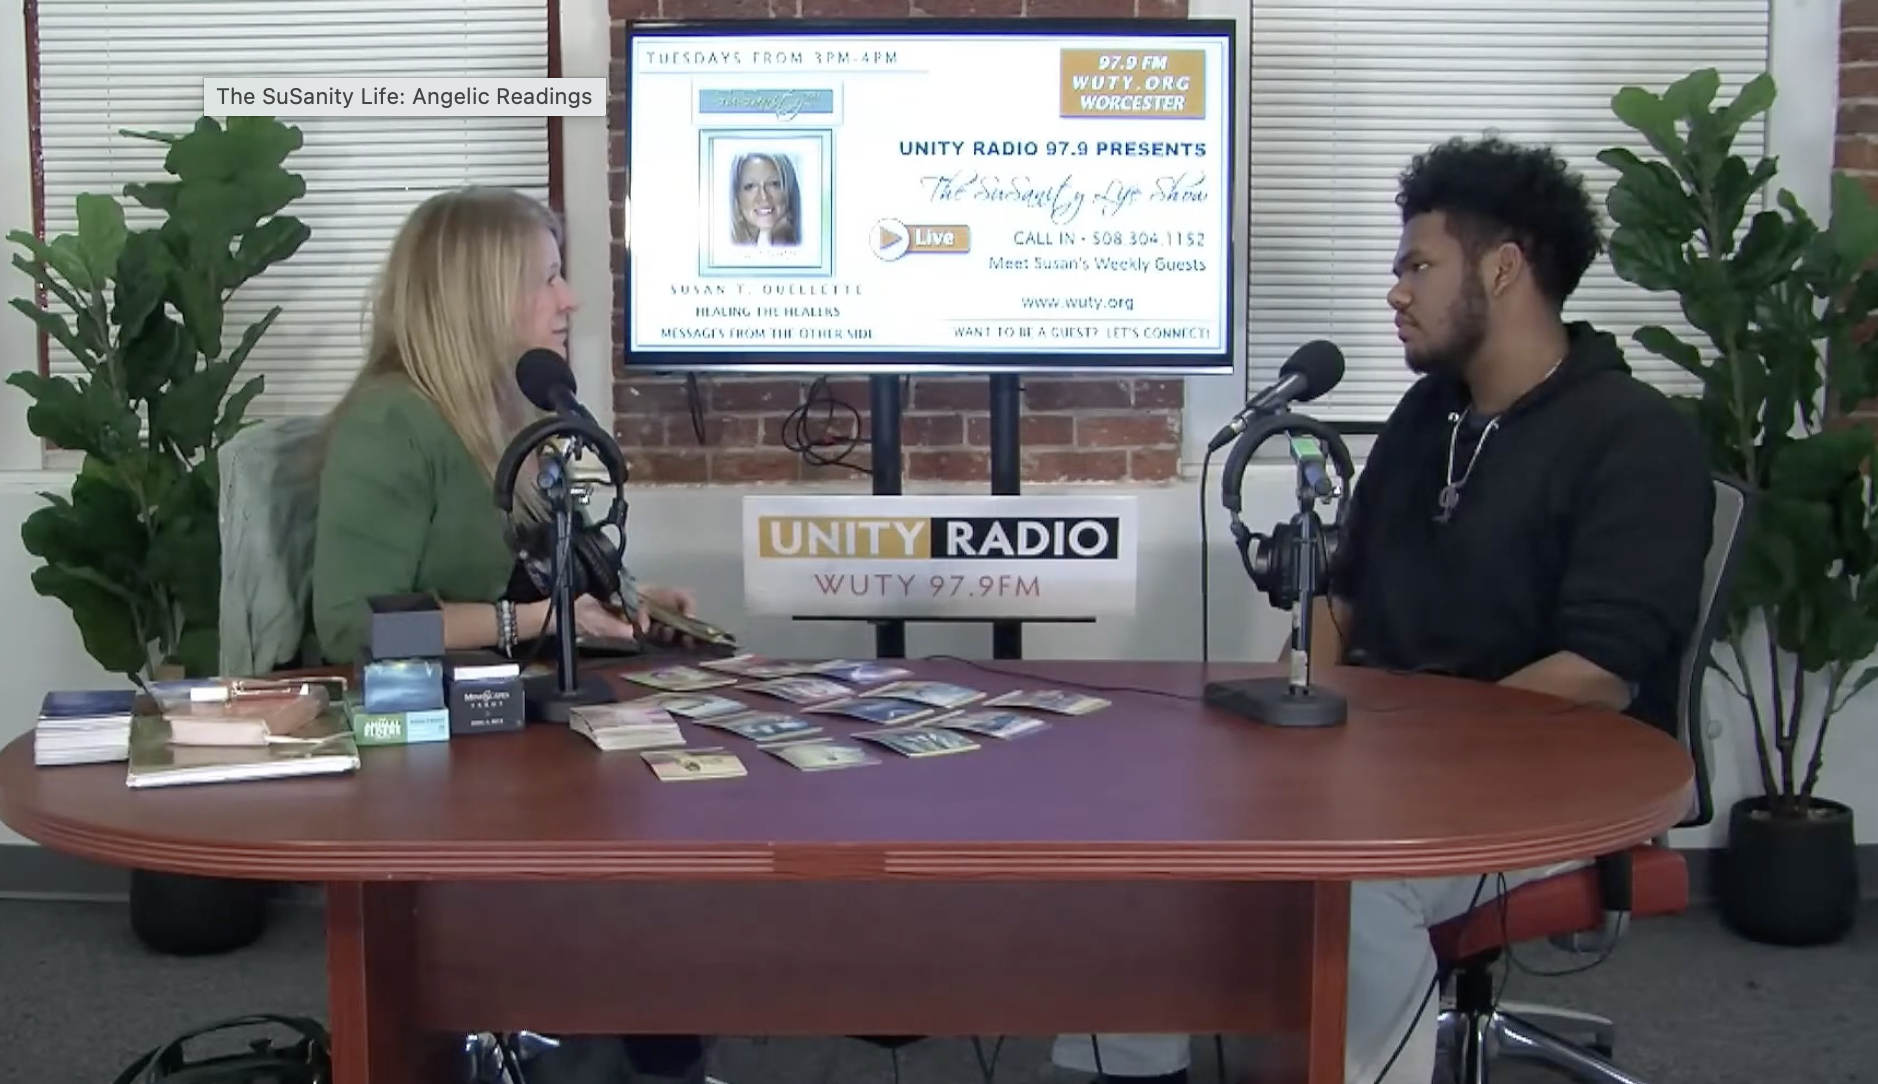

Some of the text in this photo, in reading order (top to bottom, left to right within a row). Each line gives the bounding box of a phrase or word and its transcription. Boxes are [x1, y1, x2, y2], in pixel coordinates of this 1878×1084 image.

[646, 51, 898, 65] TUESDAYS FROM 3PM-4PM
[1097, 55, 1168, 70] 97.9 FM
[1072, 75, 1190, 90] WUTY.ORG
[1080, 95, 1185, 111] WORCESTER
[899, 141, 1207, 157] UNITY RADIO 97.9 PRESENTS
[920, 169, 978, 202] The
[974, 174, 1085, 225] SuSanity
[1150, 170, 1208, 202] Show
[915, 229, 955, 247] Live
[1013, 231, 1206, 247] CALL IN 508.304.1152
[989, 256, 1207, 274] Meet Susan's Weekly Guests
[670, 284, 726, 296] SUSAN
[763, 284, 864, 296] OUELLETTE
[1021, 295, 1135, 311] www.wuty.org
[695, 306, 841, 318] HEALING THE HEALERS
[661, 327, 726, 340] MESSAGES
[729, 328, 766, 340] FROM
[770, 328, 793, 340] THE
[799, 328, 843, 340] OTHER
[953, 326, 990, 339] WANT
[997, 326, 1015, 339] TO
[1018, 326, 1034, 339] BE
[1037, 326, 1047, 339] A
[1050, 326, 1099, 339] GUEST?
[1106, 326, 1139, 339] LET'S
[770, 520, 1110, 556] UNITY RADIO
[813, 573, 1041, 597] WUTY 97.9FM
